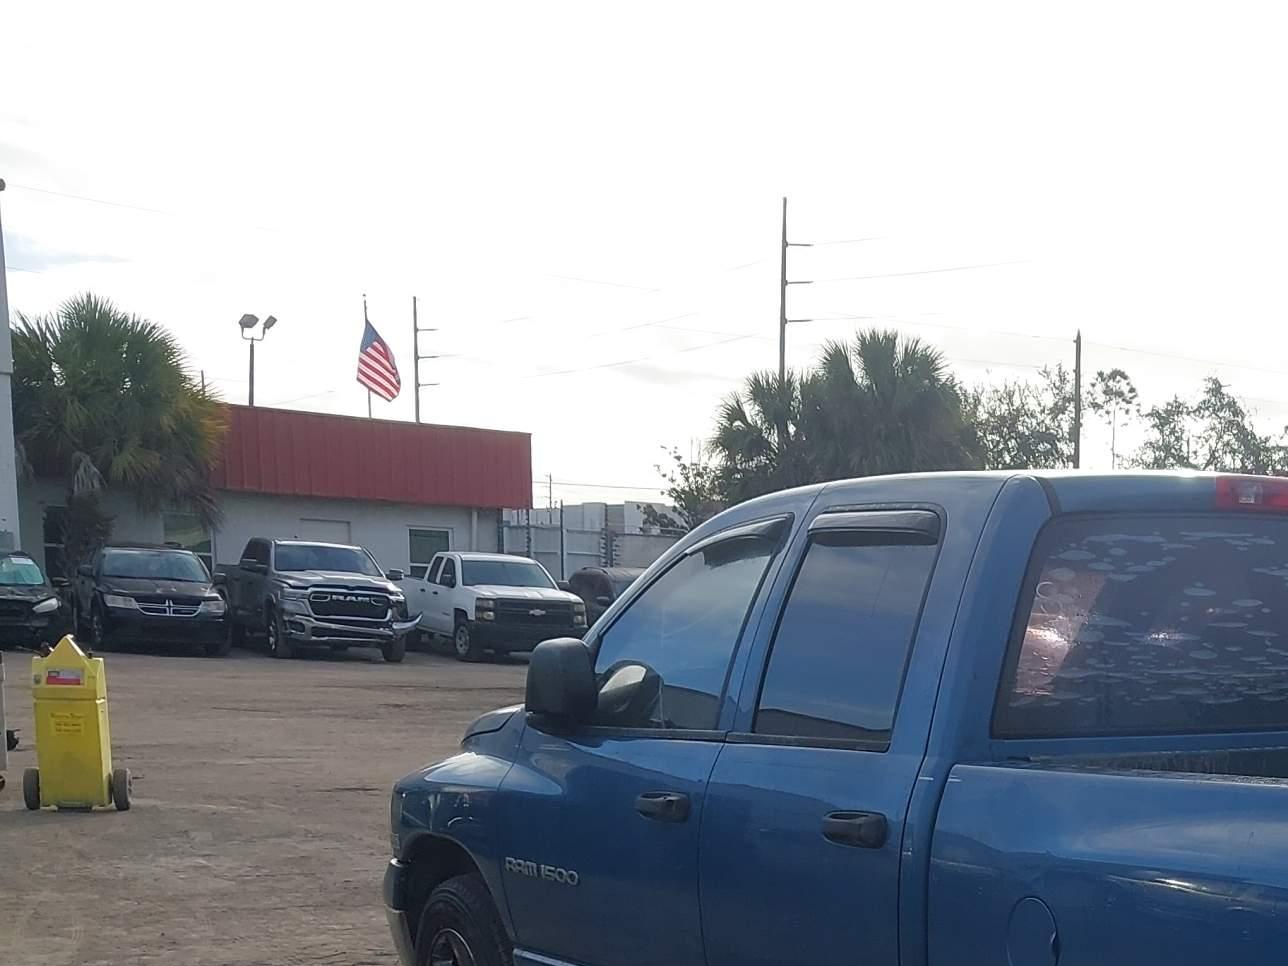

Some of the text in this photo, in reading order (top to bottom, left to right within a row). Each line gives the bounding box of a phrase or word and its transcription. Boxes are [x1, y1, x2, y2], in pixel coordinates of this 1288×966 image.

[331, 594, 371, 603] RAM
[505, 856, 579, 886] RAM 1500
